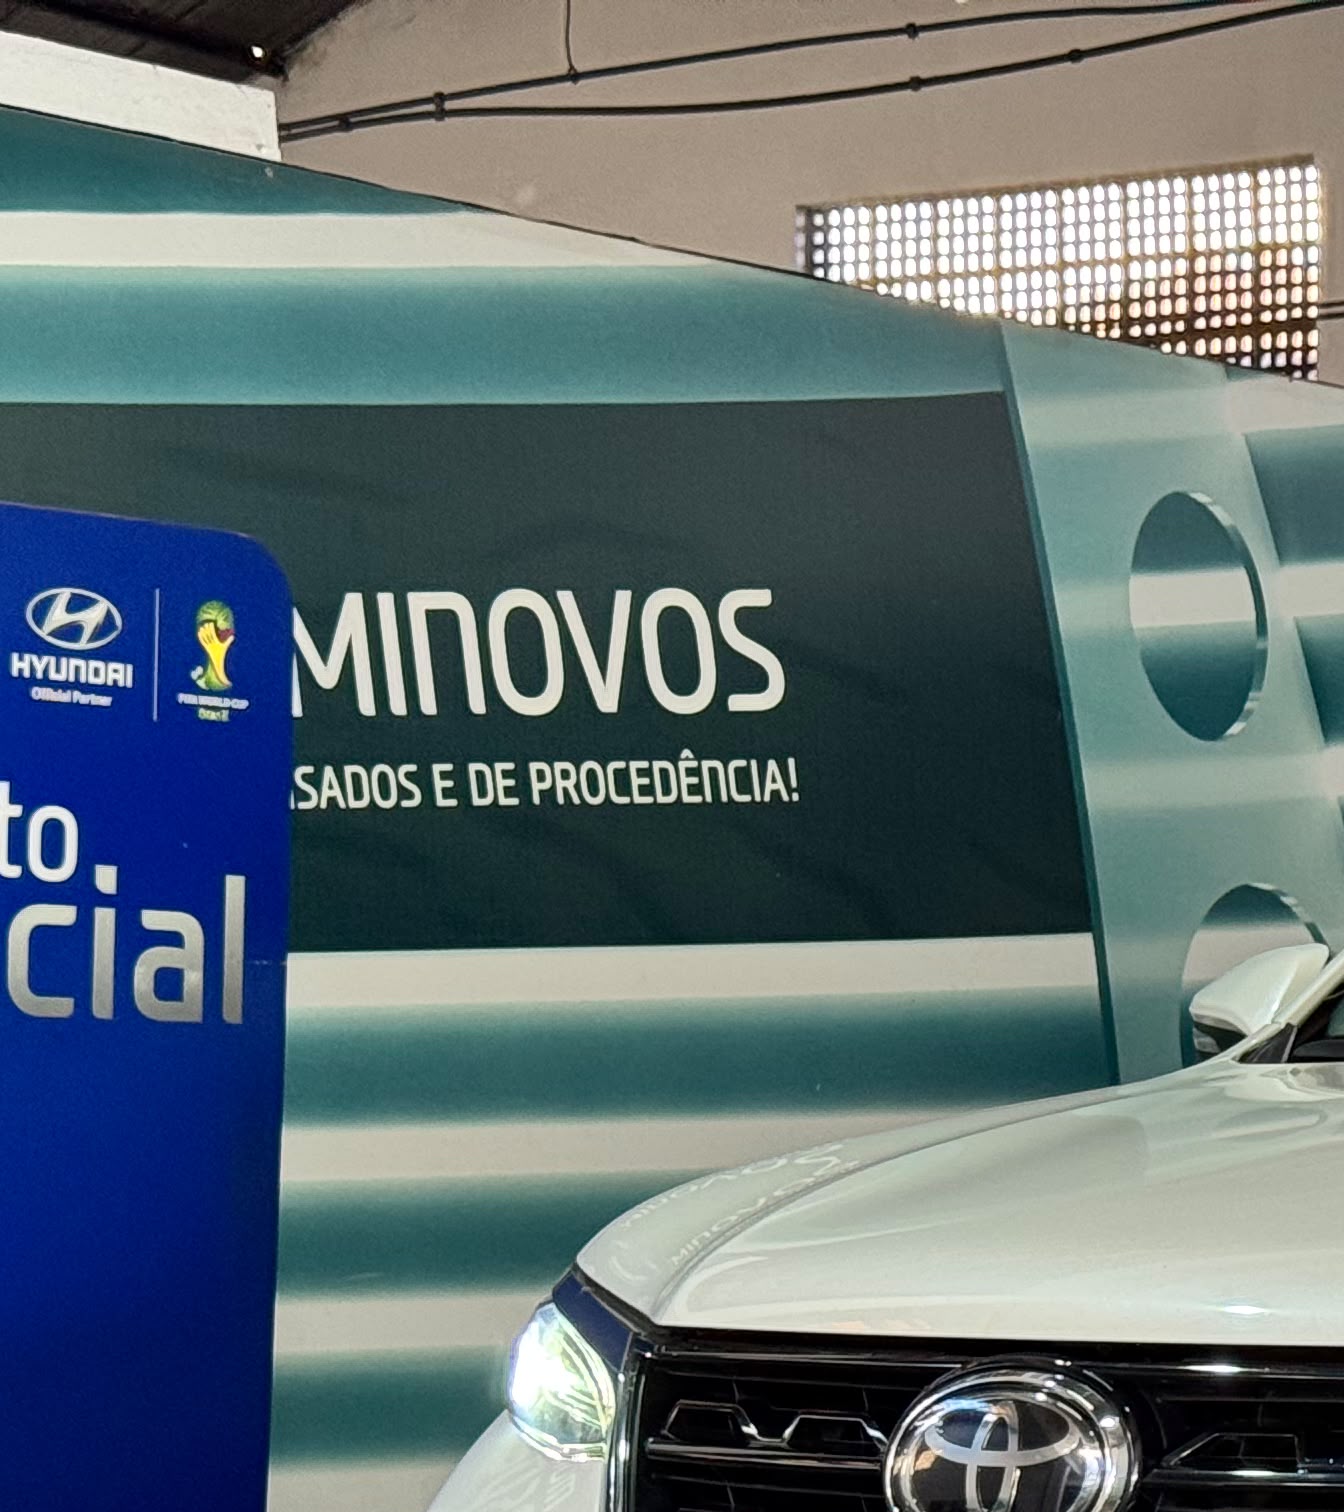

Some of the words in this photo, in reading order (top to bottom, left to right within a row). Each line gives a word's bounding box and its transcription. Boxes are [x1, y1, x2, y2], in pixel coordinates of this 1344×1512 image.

[11, 652, 133, 689] HYUNDAI
[292, 587, 785, 718] MINOVOS
[290, 763, 422, 810] SADOS
[431, 762, 459, 808] E
[467, 761, 520, 807] DE
[528, 748, 800, 806] PROCEDÊNCIA!
[7, 864, 247, 1024] cial
